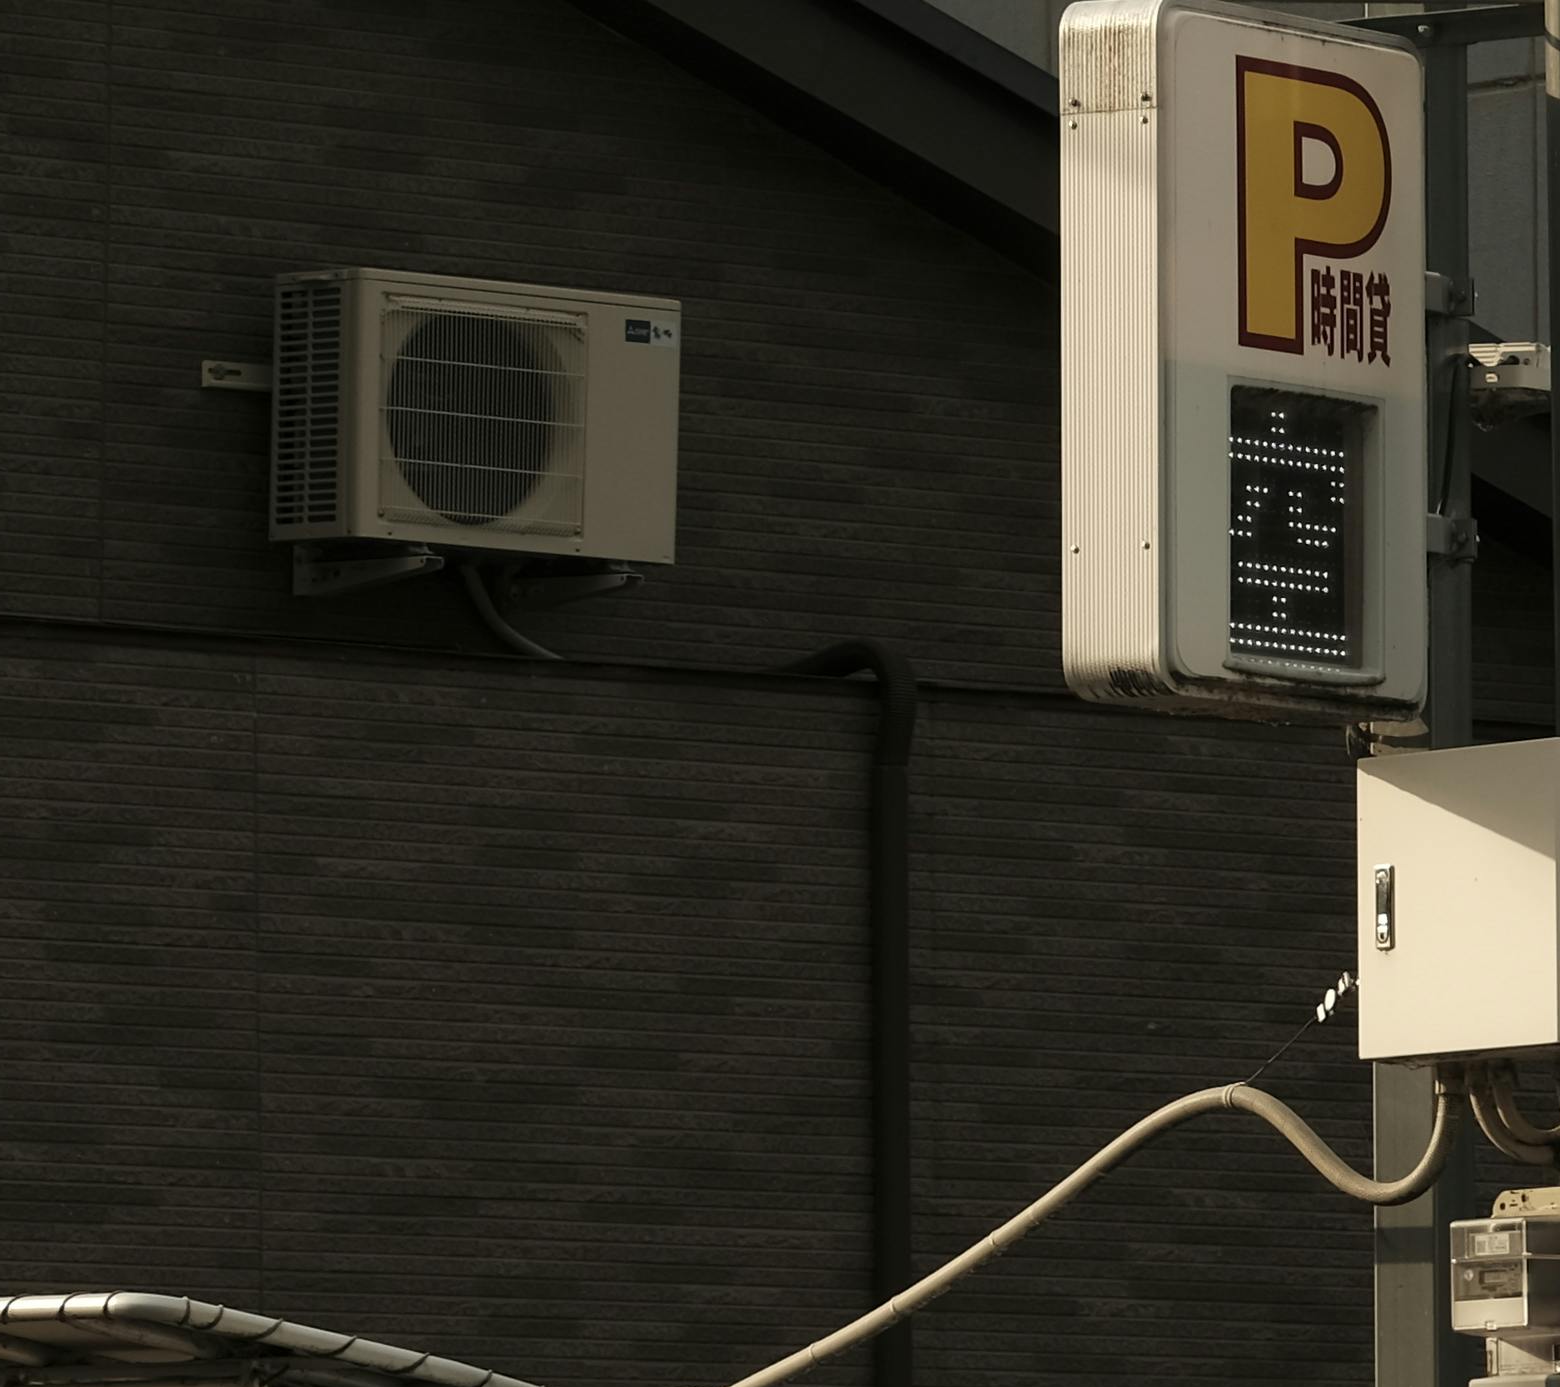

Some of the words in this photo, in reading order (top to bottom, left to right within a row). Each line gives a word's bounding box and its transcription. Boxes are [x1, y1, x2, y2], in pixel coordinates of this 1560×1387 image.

[1235, 54, 1392, 356] P
[1310, 265, 1392, 368] 時間貸
